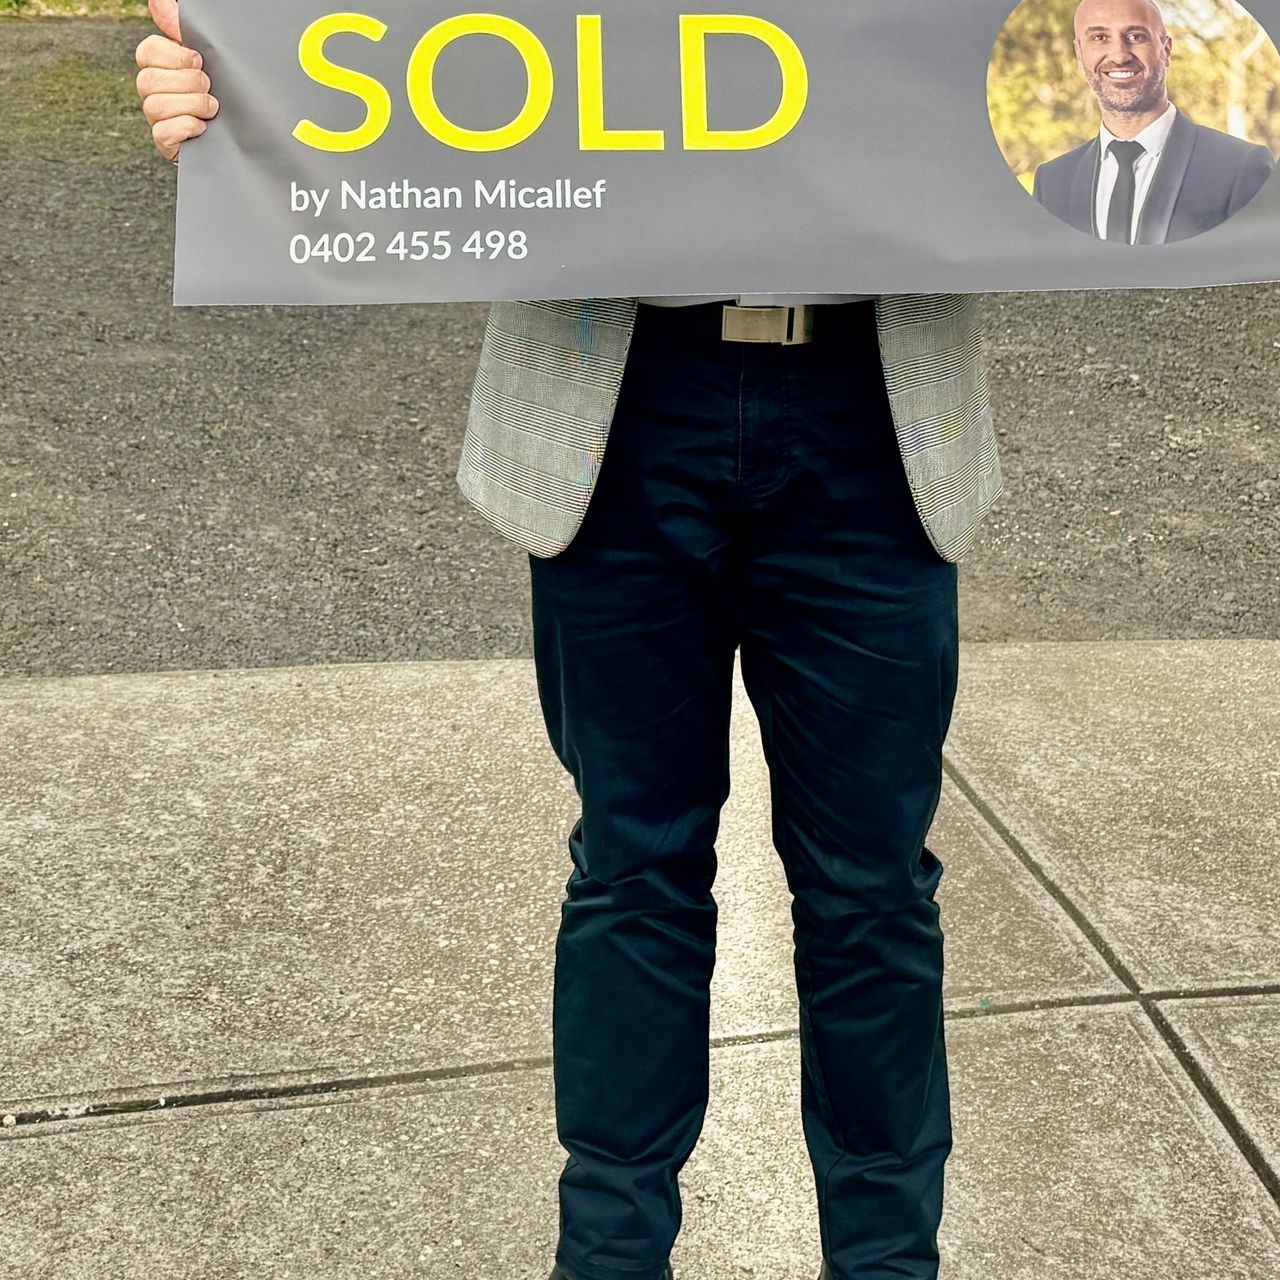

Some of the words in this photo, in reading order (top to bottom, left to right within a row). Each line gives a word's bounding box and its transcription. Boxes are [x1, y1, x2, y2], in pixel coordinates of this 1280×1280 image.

[292, 13, 808, 152] SOLD
[291, 182, 330, 217] by
[342, 179, 462, 210] Nathan
[475, 179, 606, 209] Micallef
[290, 232, 376, 263] 0402
[386, 231, 452, 261] 455
[462, 230, 528, 260] 498
